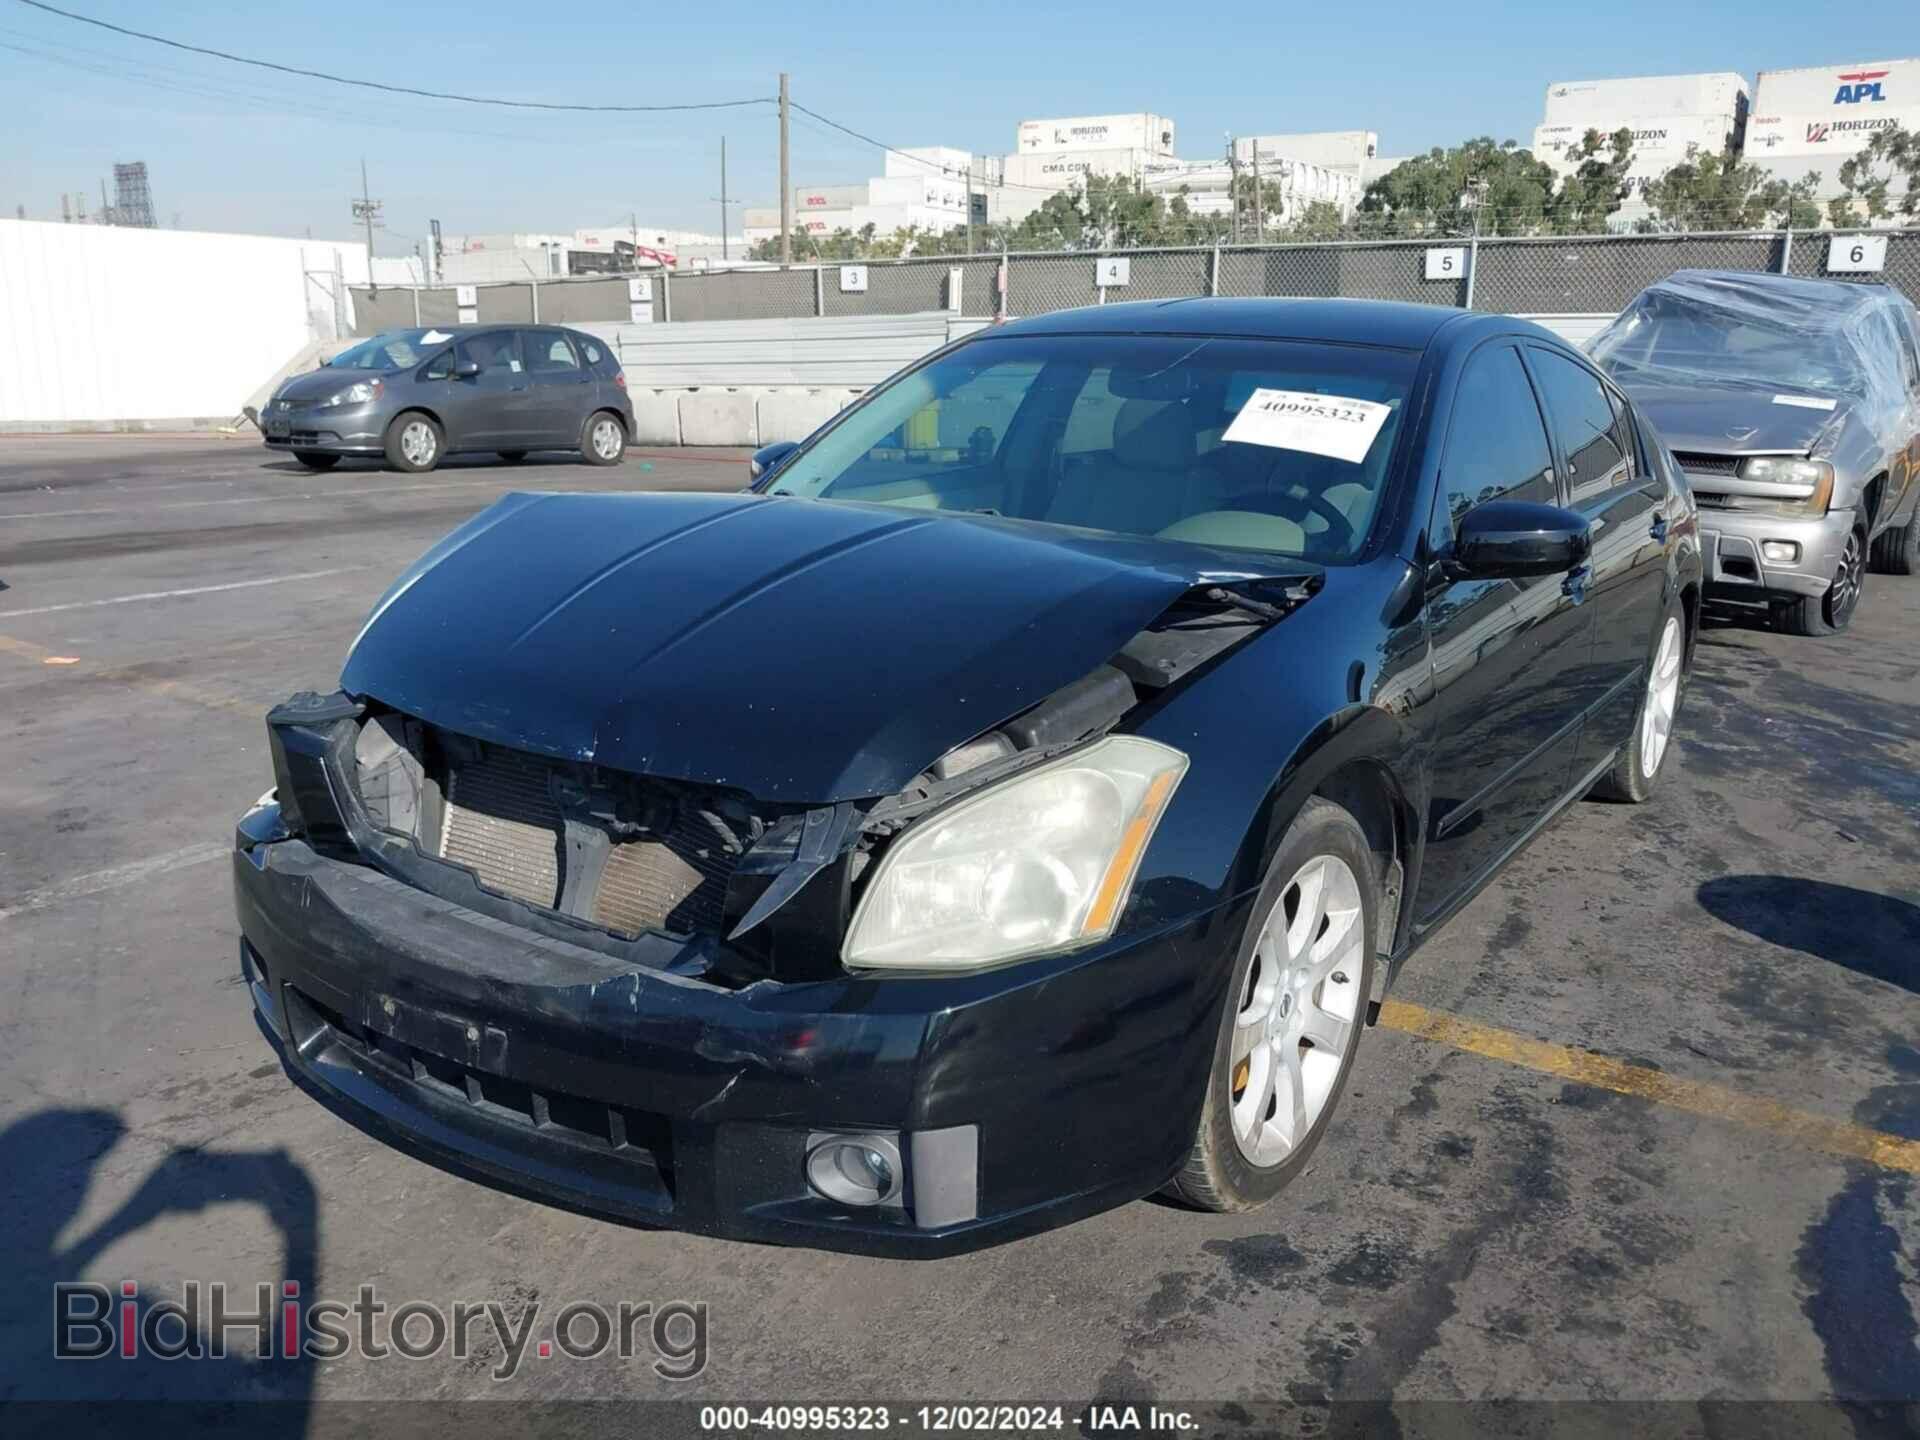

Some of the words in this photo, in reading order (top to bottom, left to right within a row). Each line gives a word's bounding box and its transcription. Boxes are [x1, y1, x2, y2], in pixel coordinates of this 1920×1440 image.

[1833, 82, 1886, 104] APL
[1832, 117, 1900, 132] HORIZON
[1609, 129, 1668, 141] HIZON
[1042, 164, 1066, 174] CMA
[1626, 176, 1650, 186] GM
[1850, 245, 1863, 263] 6
[1442, 256, 1452, 271] 5
[1110, 265, 1117, 278] 4
[850, 272, 858, 285] 3
[638, 283, 645, 296] 2
[1258, 401, 1367, 424] 40995323
